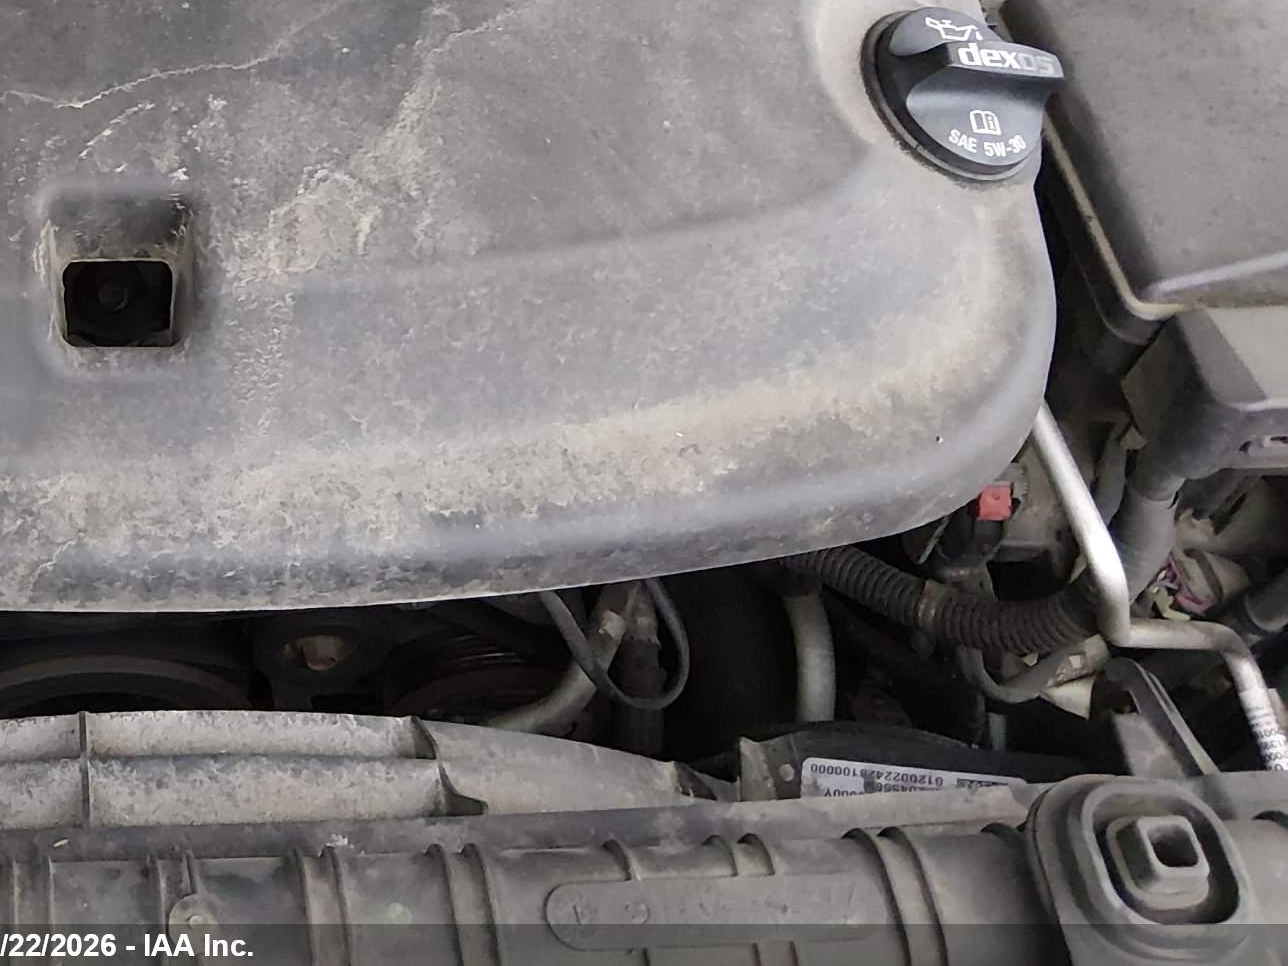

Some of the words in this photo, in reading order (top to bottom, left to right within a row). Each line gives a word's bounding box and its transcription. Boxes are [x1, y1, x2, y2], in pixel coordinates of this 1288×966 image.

[957, 42, 1053, 75] dexos
[948, 129, 978, 153] SAE
[983, 134, 1027, 157] 5W-30
